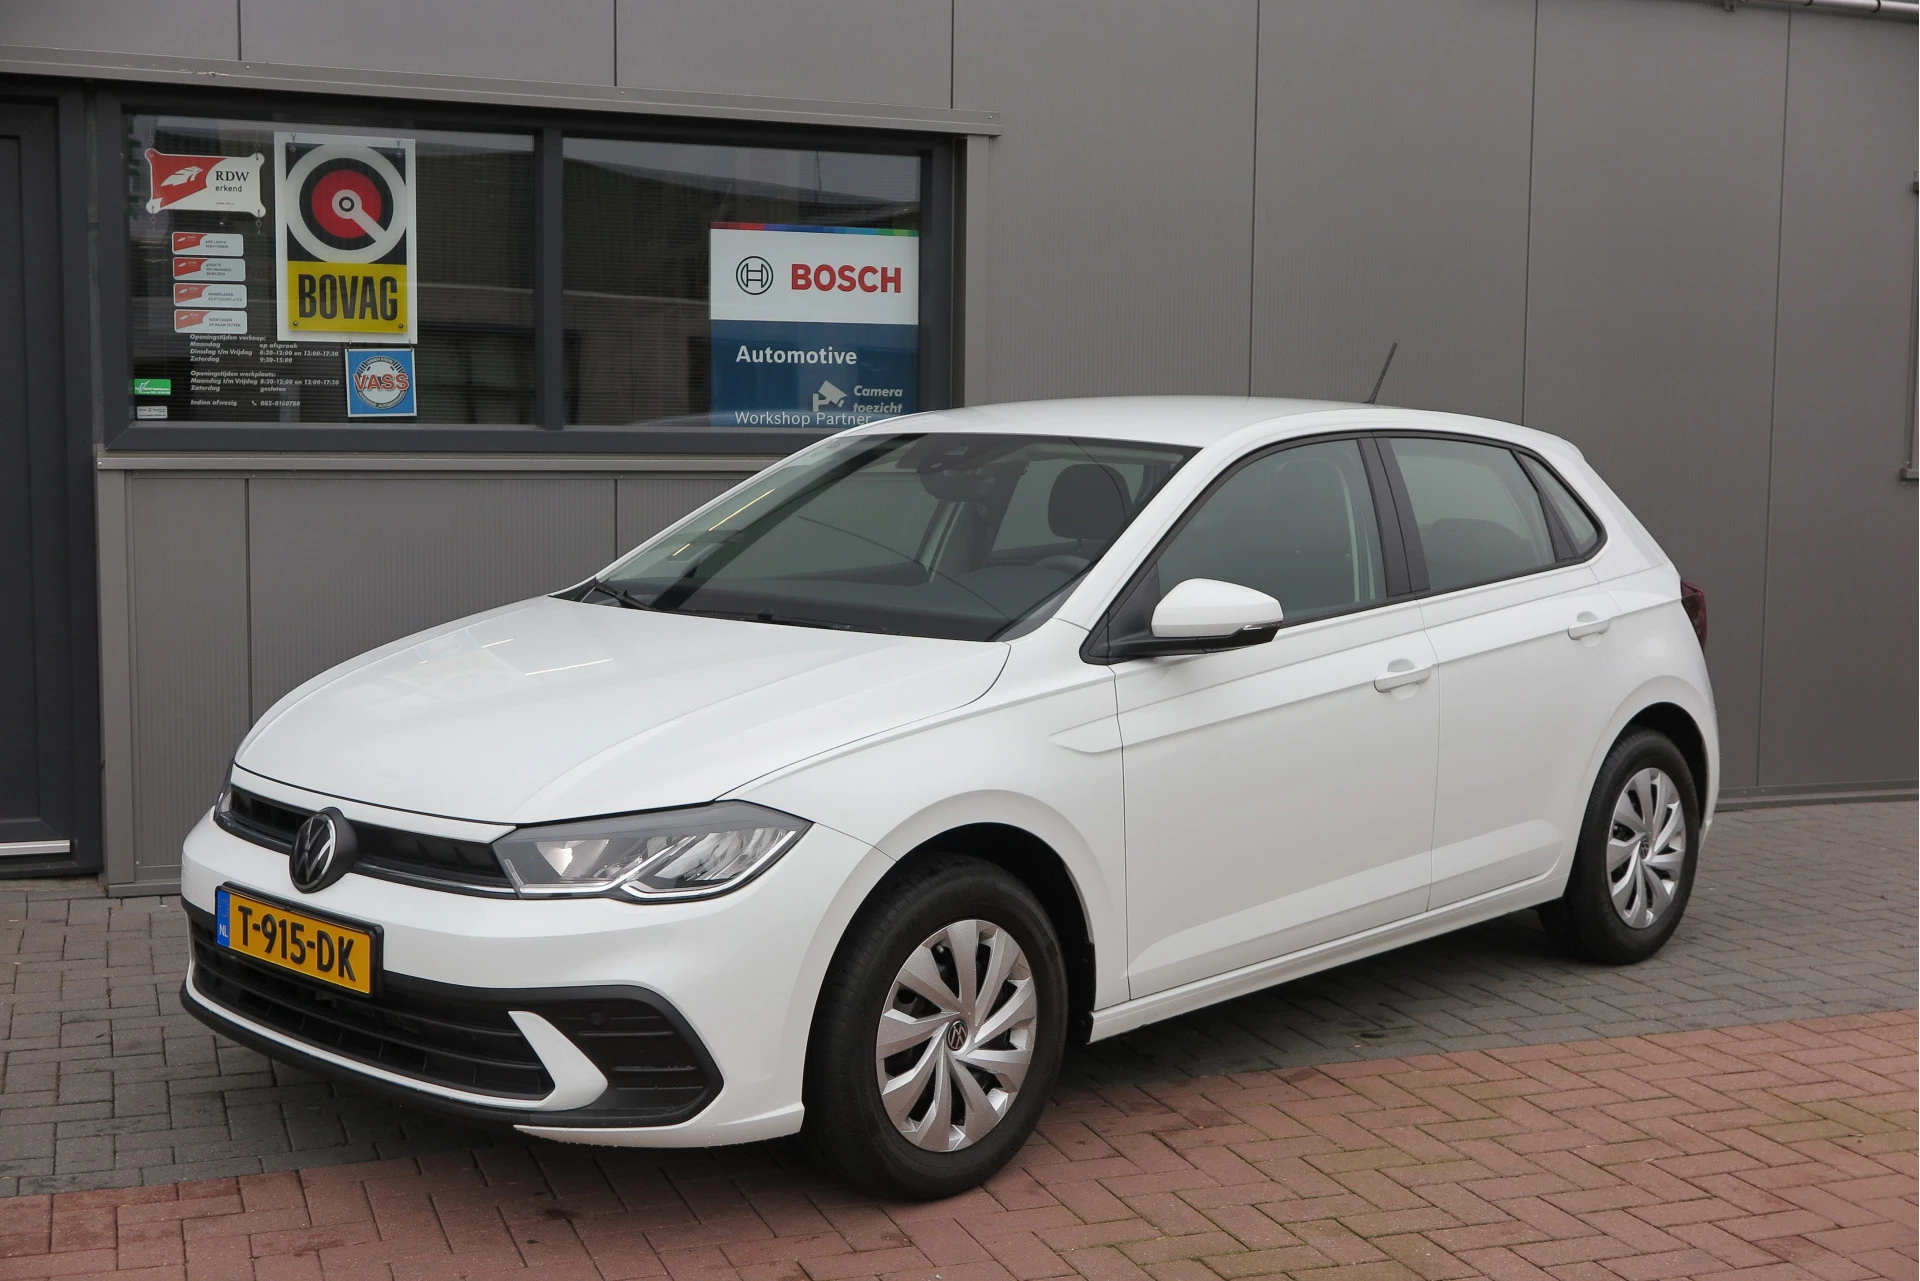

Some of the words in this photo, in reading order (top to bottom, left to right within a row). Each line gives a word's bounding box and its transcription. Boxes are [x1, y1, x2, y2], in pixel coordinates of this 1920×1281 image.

[215, 171, 250, 182] RDW
[791, 263, 902, 294] BOSCH
[298, 273, 398, 321] BOVAG
[189, 333, 237, 341] Openingstijden
[239, 334, 267, 342] verkoop:
[189, 348, 217, 356] Dinsdag
[736, 345, 858, 365] Automotive
[189, 355, 220, 363] Zaterdag
[190, 384, 221, 392] Zaterdag
[353, 373, 410, 391] VASS
[853, 385, 904, 397] Camera
[212, 399, 238, 407] afwezig
[853, 401, 904, 414] toezicht
[735, 411, 811, 428] Workshop
[816, 411, 871, 426] Partner
[219, 923, 229, 938] NL
[237, 905, 357, 982] T-915-DK
